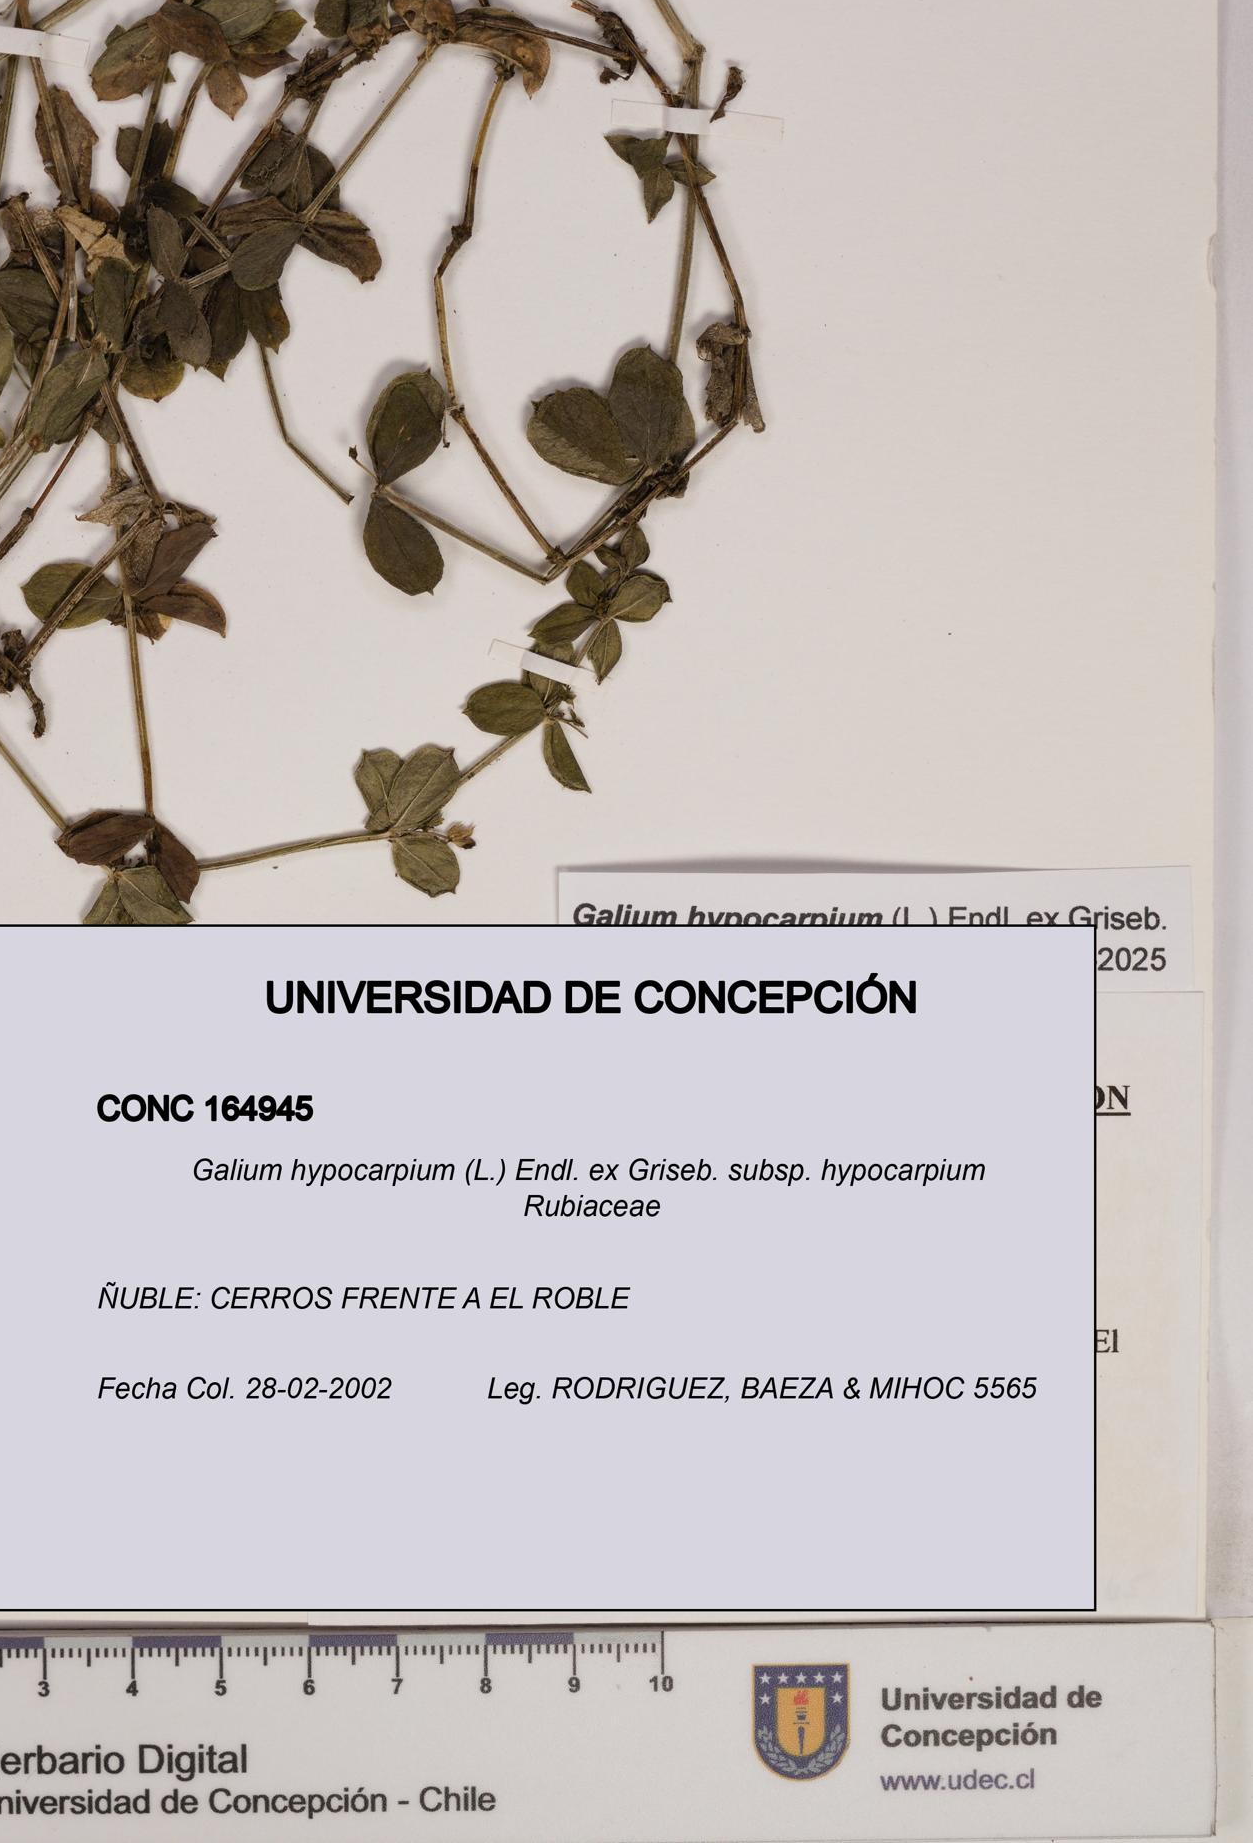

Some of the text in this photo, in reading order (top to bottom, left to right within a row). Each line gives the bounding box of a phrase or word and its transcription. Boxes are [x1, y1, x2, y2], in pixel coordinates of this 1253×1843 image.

[892, 906, 938, 925] (L)
[948, 906, 1008, 925] Endl
[1068, 905, 1167, 931] Griseb.
[1097, 946, 1167, 972] 2025
[37, 1678, 51, 1698] 3
[125, 1678, 139, 1697] 4
[214, 1677, 228, 1697] 5
[302, 1677, 316, 1696] 6
[390, 1676, 404, 1695] 7
[479, 1675, 493, 1694] 8
[567, 1674, 581, 1693] 9
[649, 1674, 675, 1693] 10
[880, 1685, 1103, 1711] Universidad de
[880, 1721, 1058, 1751] Concepción
[137, 1743, 249, 1783] Digital
[879, 1768, 1035, 1791] www.udec.cl
[160, 1788, 199, 1815] de
[208, 1786, 388, 1820] Concepción
[419, 1785, 497, 1813] Chile
